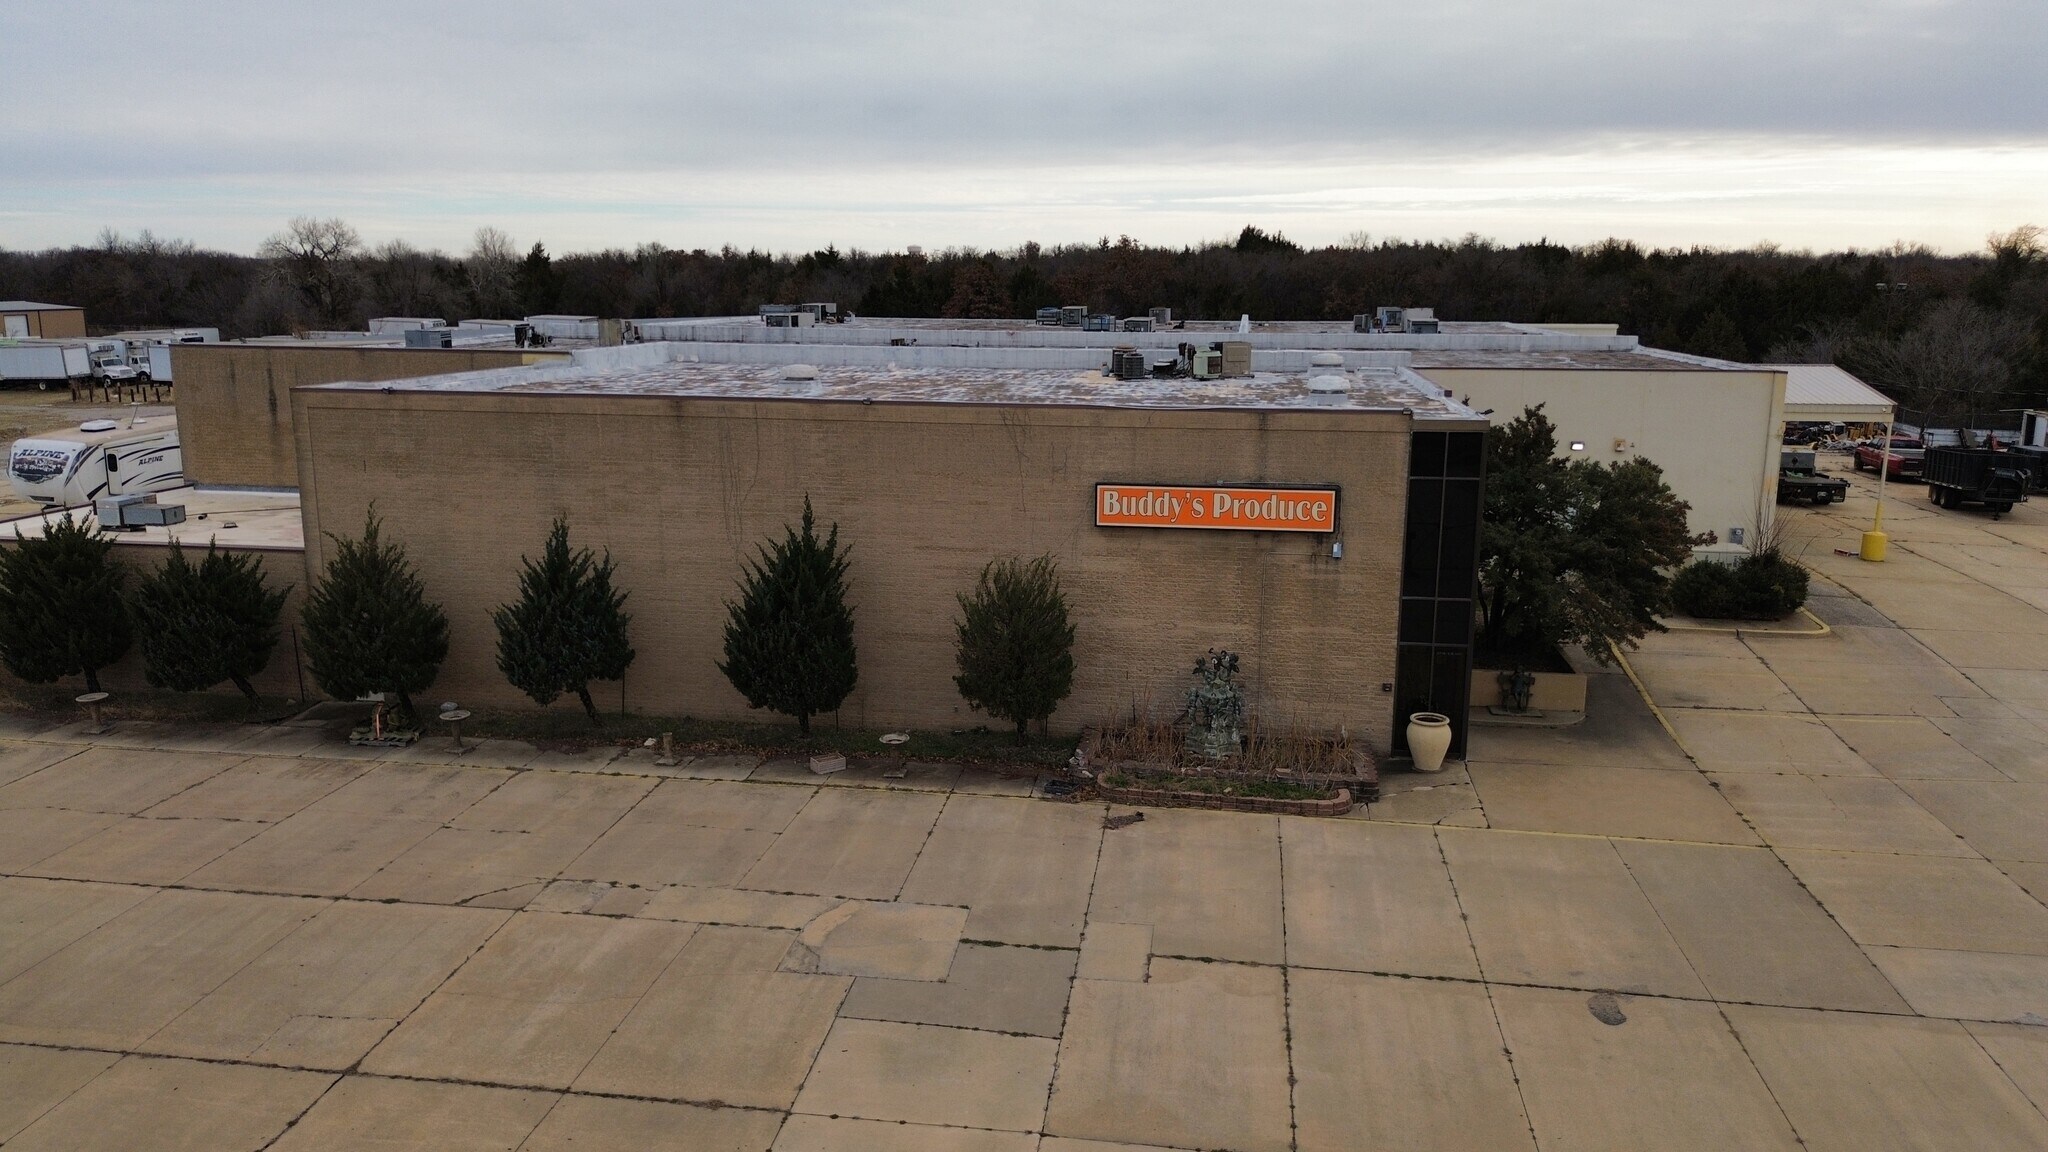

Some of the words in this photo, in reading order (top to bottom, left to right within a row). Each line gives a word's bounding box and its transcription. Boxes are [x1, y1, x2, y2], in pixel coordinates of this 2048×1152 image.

[19, 449, 65, 459] ALPINE
[138, 455, 164, 466] ALPINE
[1102, 490, 1205, 523] Buddy's
[1212, 492, 1328, 521] Produce
